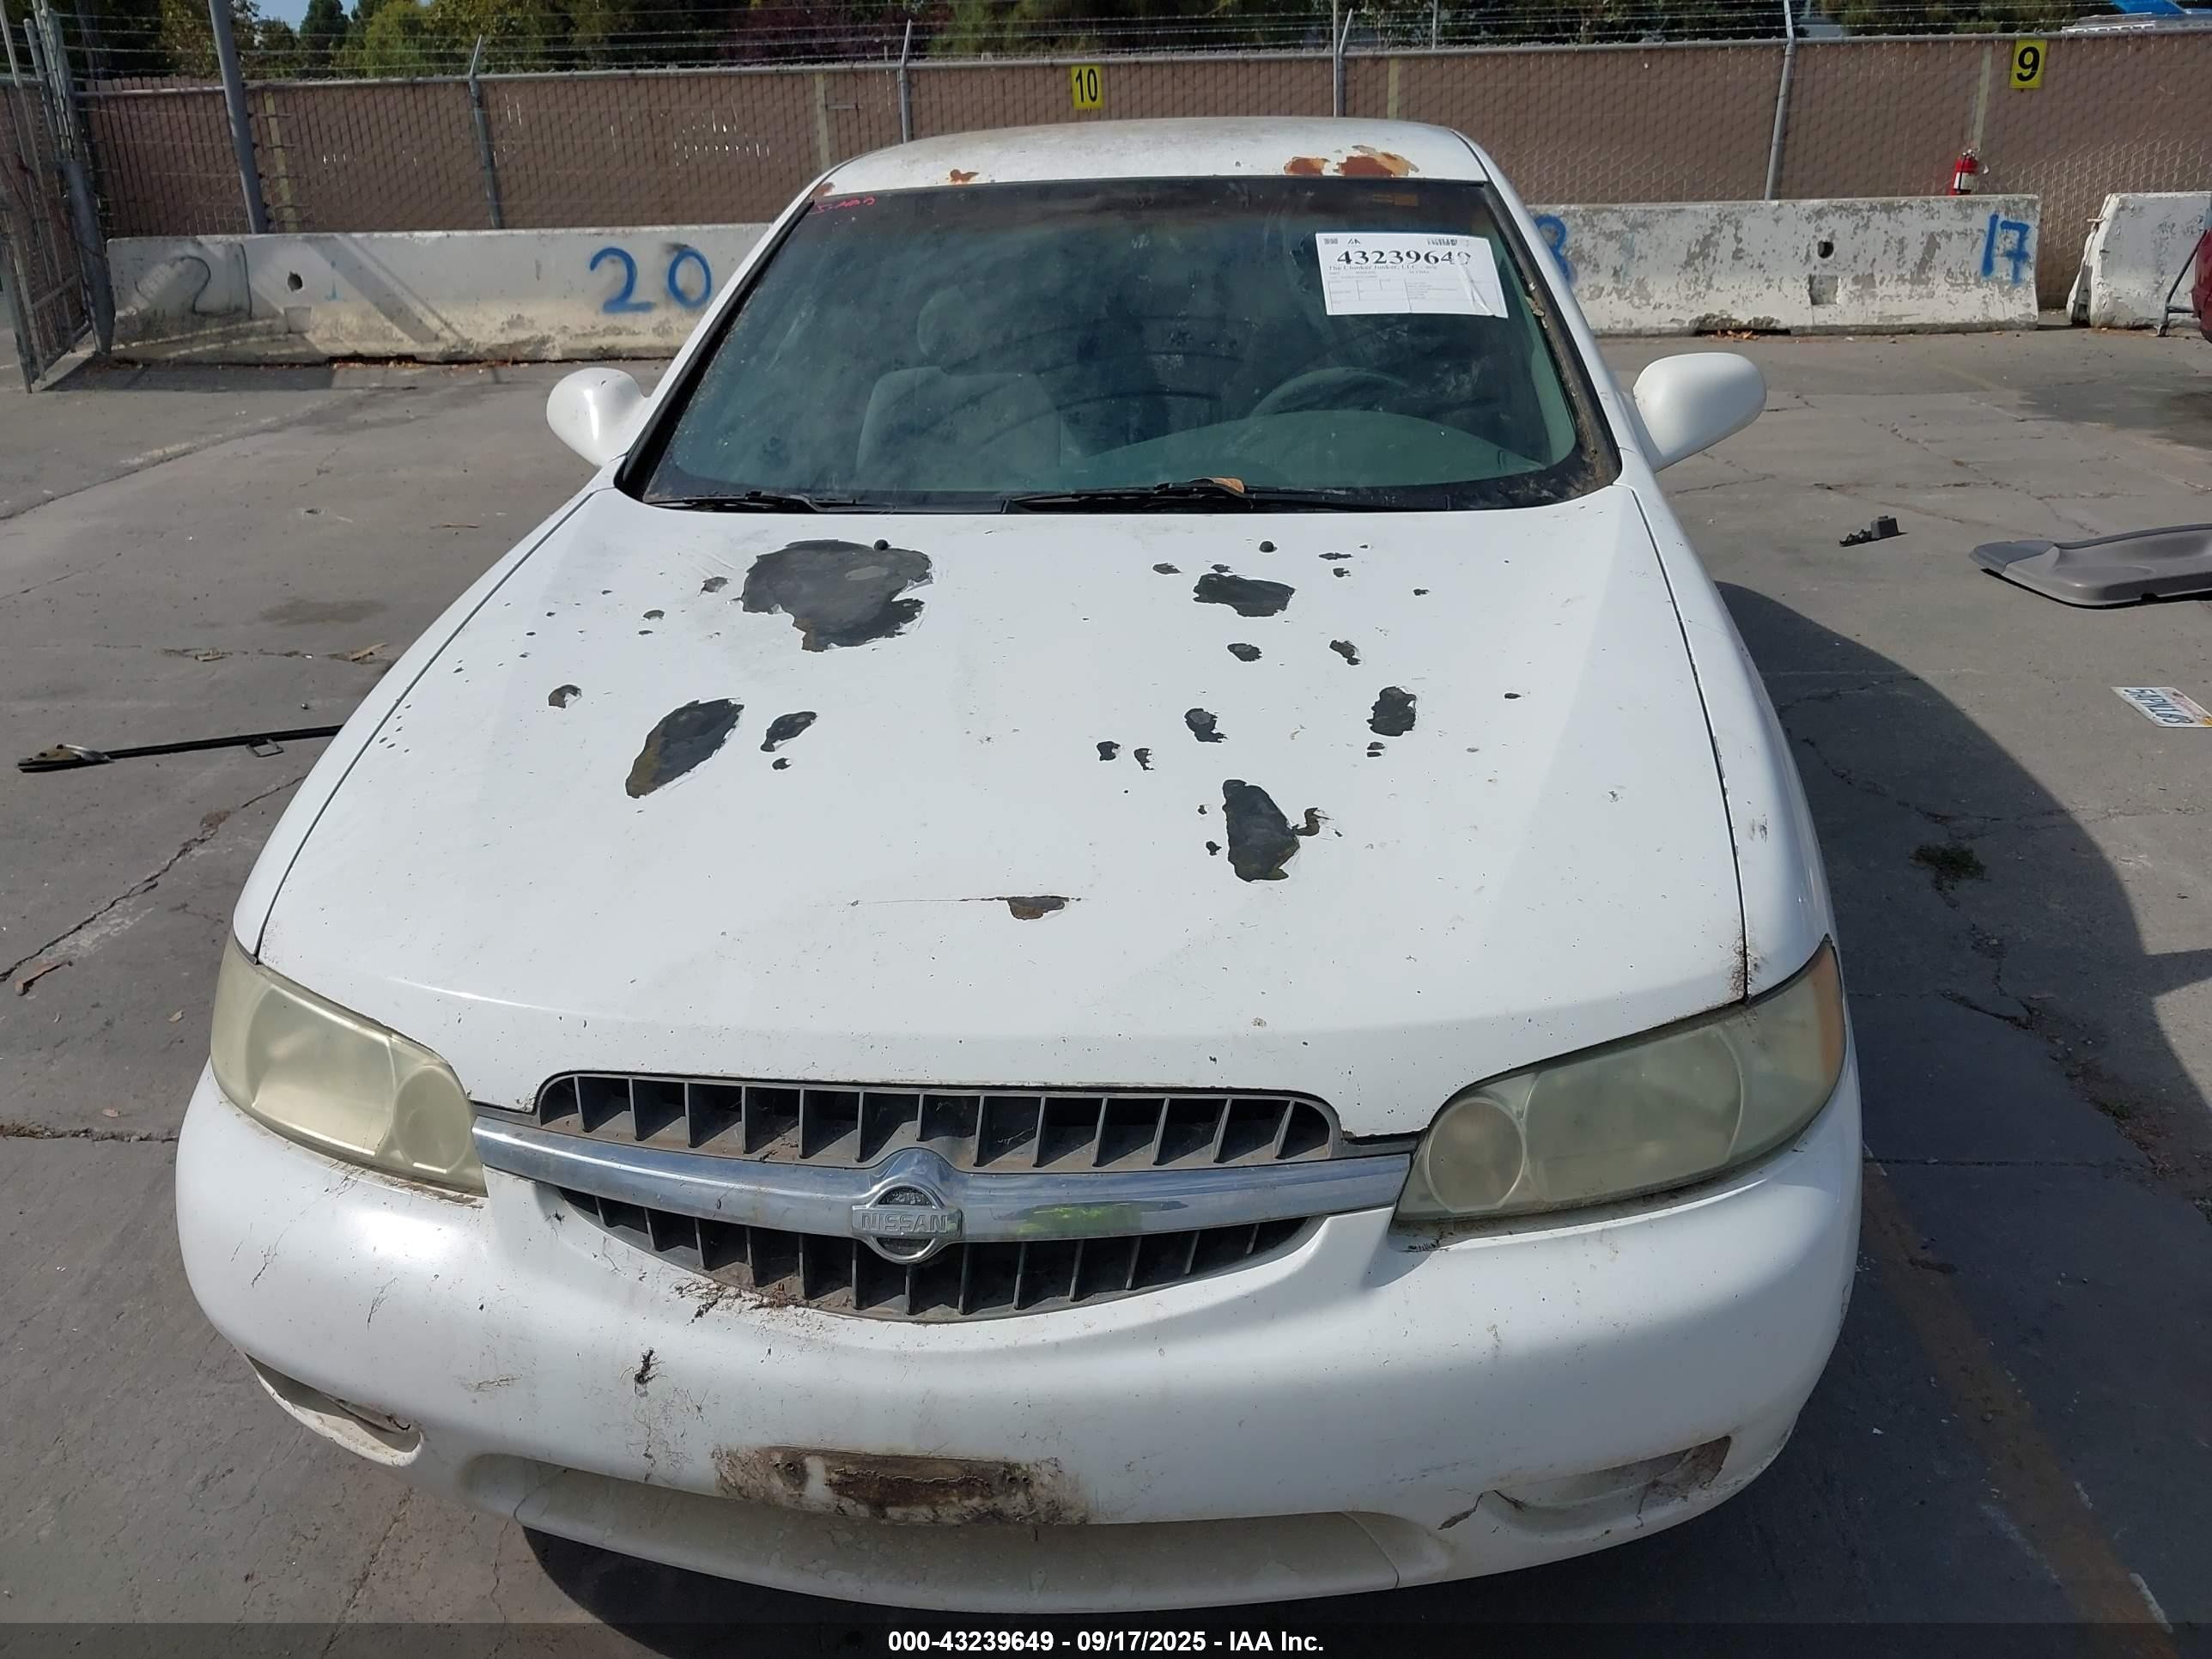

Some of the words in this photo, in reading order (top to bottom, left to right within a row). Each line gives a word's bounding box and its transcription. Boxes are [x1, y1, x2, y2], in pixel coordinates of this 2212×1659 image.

[2016, 46, 2040, 82] 9
[1075, 68, 1097, 103] 10
[1337, 250, 1472, 265] 43239649
[1981, 214, 2030, 286] 17
[590, 246, 712, 313] 20
[861, 1212, 948, 1233] NISSAN
